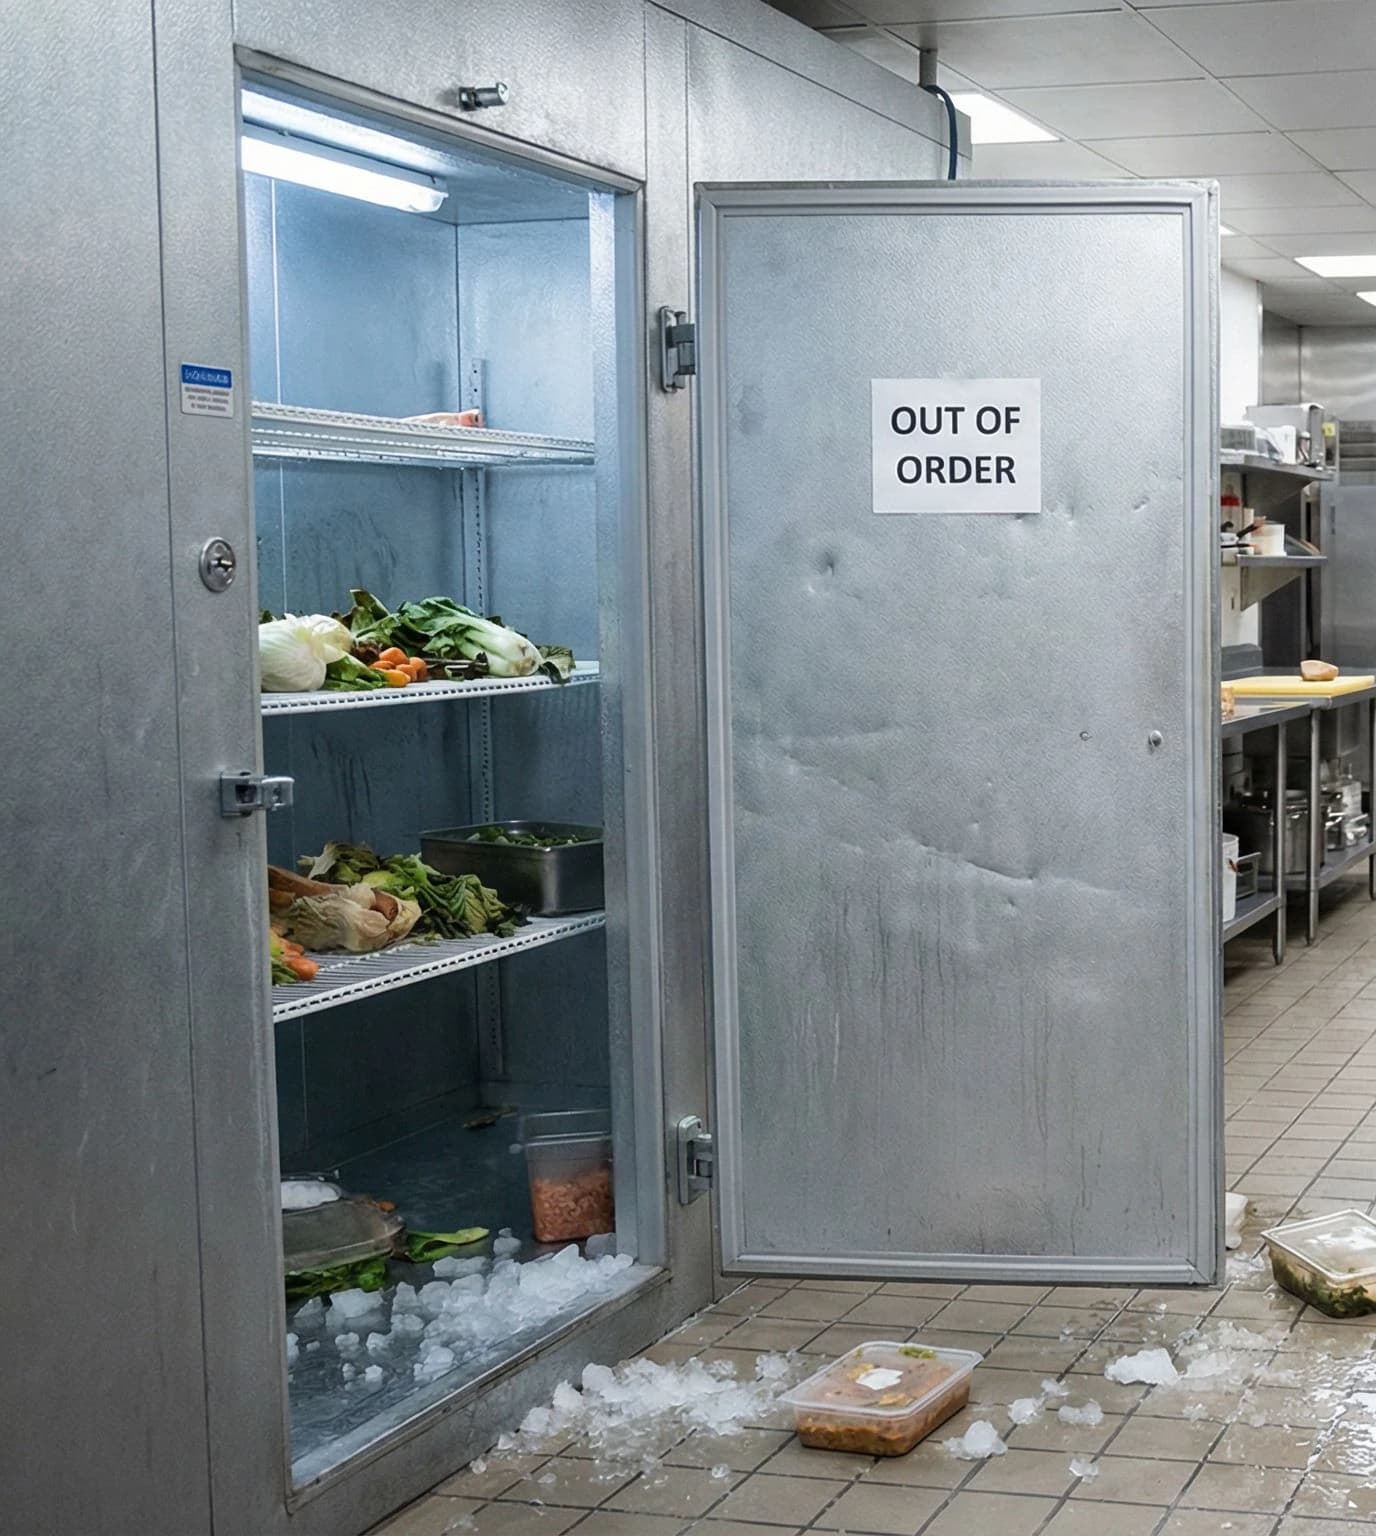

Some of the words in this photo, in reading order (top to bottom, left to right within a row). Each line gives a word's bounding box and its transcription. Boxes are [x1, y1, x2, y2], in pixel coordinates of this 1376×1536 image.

[891, 406, 965, 435] OUT
[976, 406, 1021, 435] OF
[896, 455, 1016, 484] ORDER
